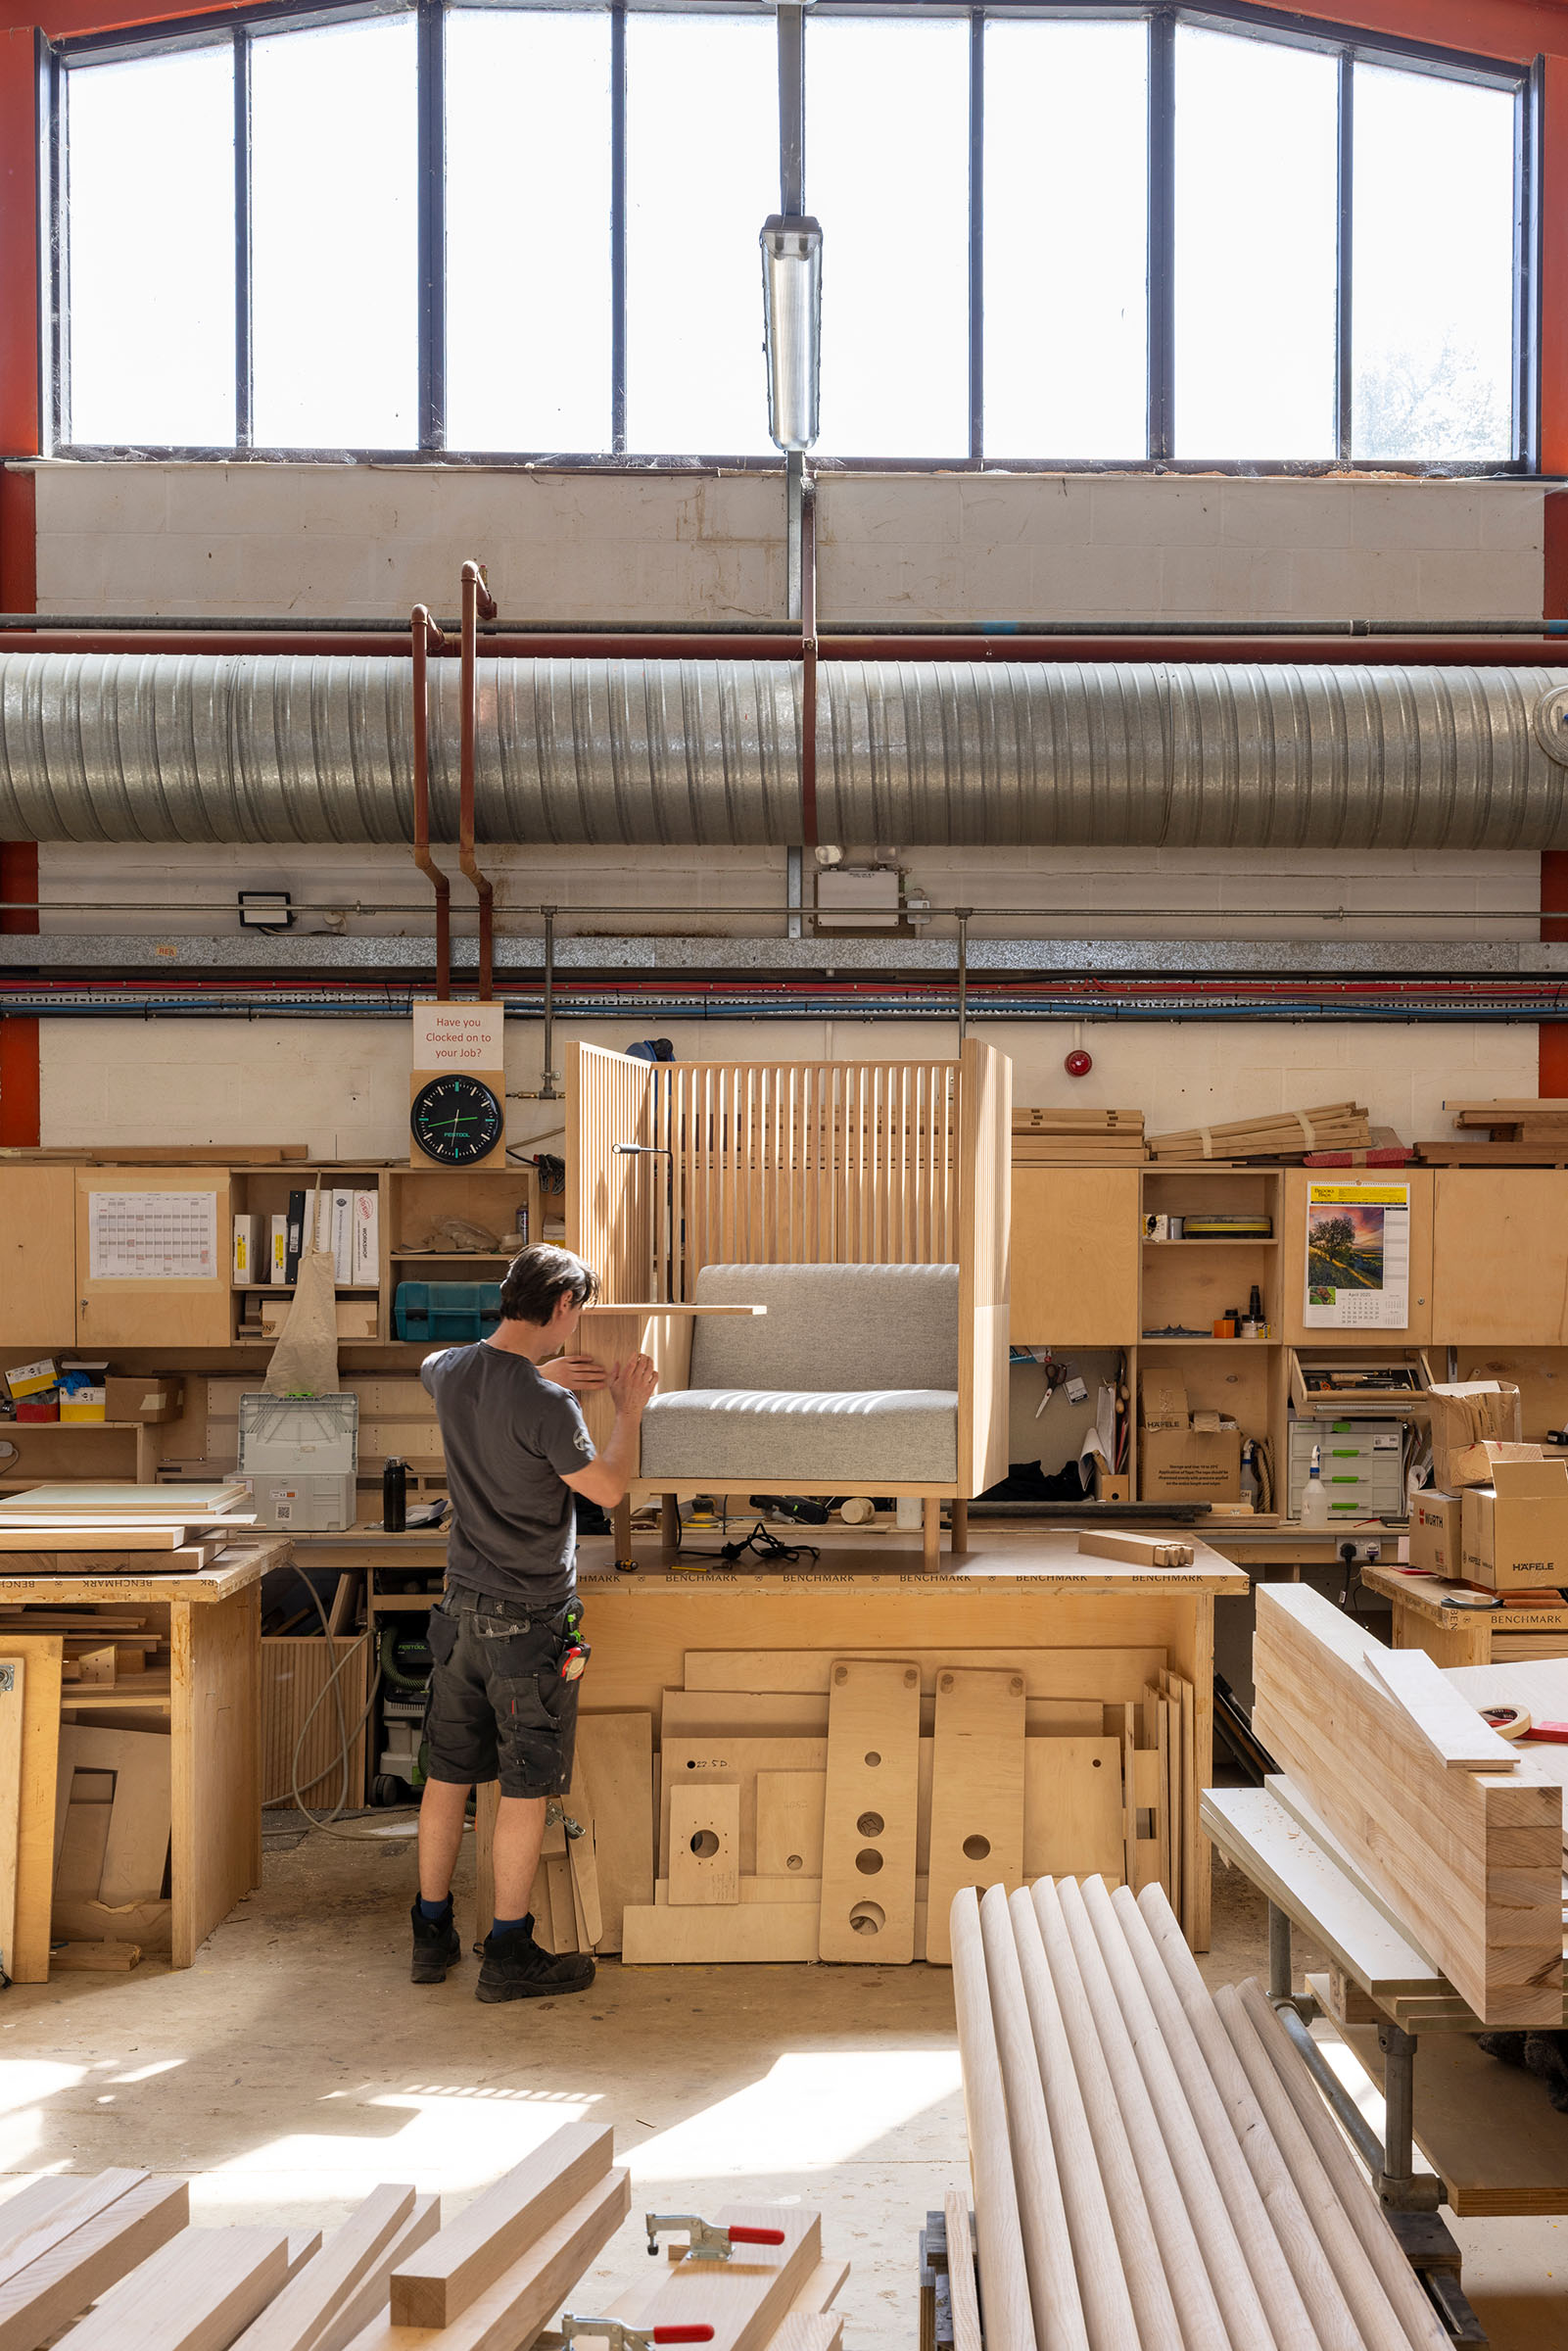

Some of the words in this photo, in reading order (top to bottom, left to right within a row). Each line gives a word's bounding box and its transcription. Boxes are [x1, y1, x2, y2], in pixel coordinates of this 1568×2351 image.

[437, 1018, 460, 1027] Have
[426, 1032, 464, 1042] Clocked
[481, 1033, 491, 1042] to
[460, 1048, 481, 1058] Job?
[1512, 1562, 1554, 1571] HÄFELE
[1491, 1615, 1562, 1624] BENCHMARK
